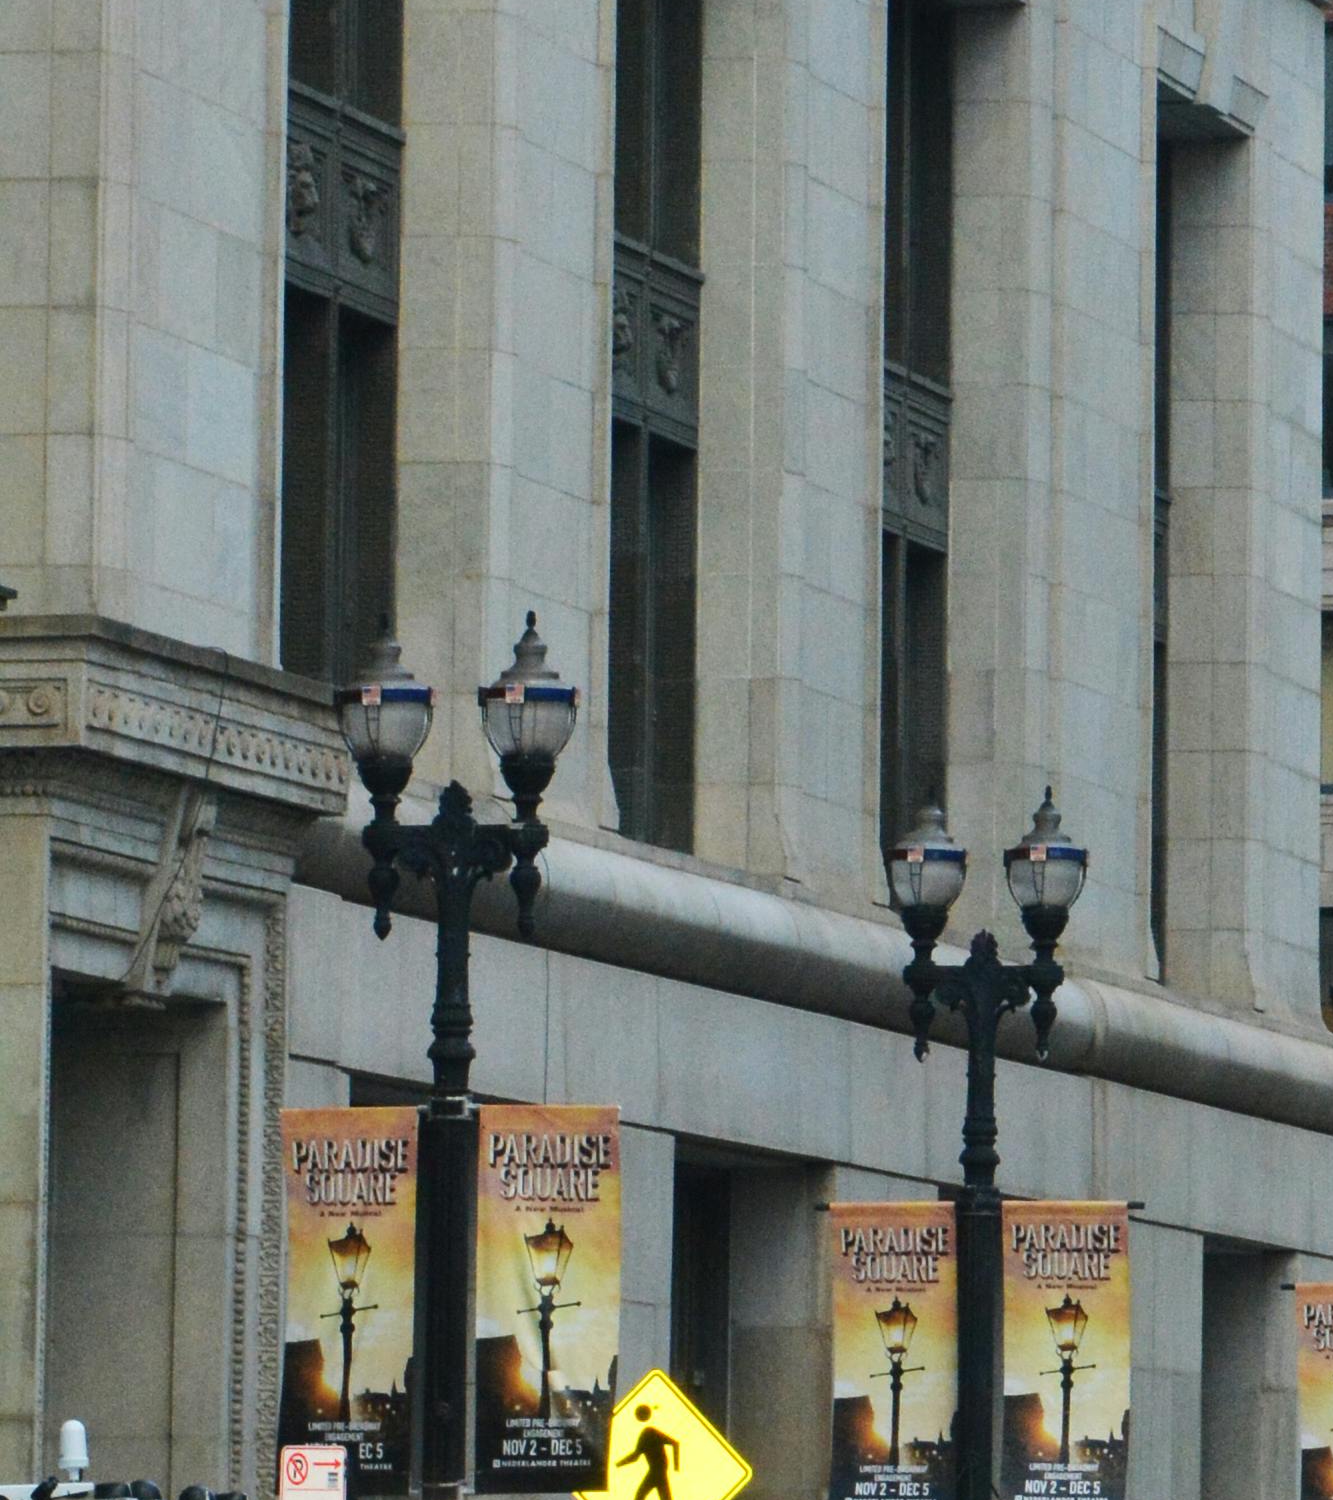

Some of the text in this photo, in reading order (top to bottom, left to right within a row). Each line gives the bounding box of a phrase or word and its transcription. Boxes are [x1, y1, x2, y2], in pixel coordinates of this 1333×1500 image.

[291, 1138, 409, 1173] PARADISE
[488, 1133, 612, 1168] PARADISE
[305, 1173, 397, 1206] SQUARE
[500, 1169, 600, 1201] SQUARE
[840, 1228, 949, 1256] PARADISE
[1012, 1224, 1121, 1254] PARADISE
[851, 1255, 940, 1283] SQUARE
[1023, 1252, 1112, 1280] SQUARE
[359, 1443, 384, 1460] EC 5
[503, 1439, 583, 1456] NOV 2 DEC 5
[855, 1482, 930, 1496] NOV 2 DEC 5
[1024, 1480, 1100, 1494] NOV 2 DEC 5
